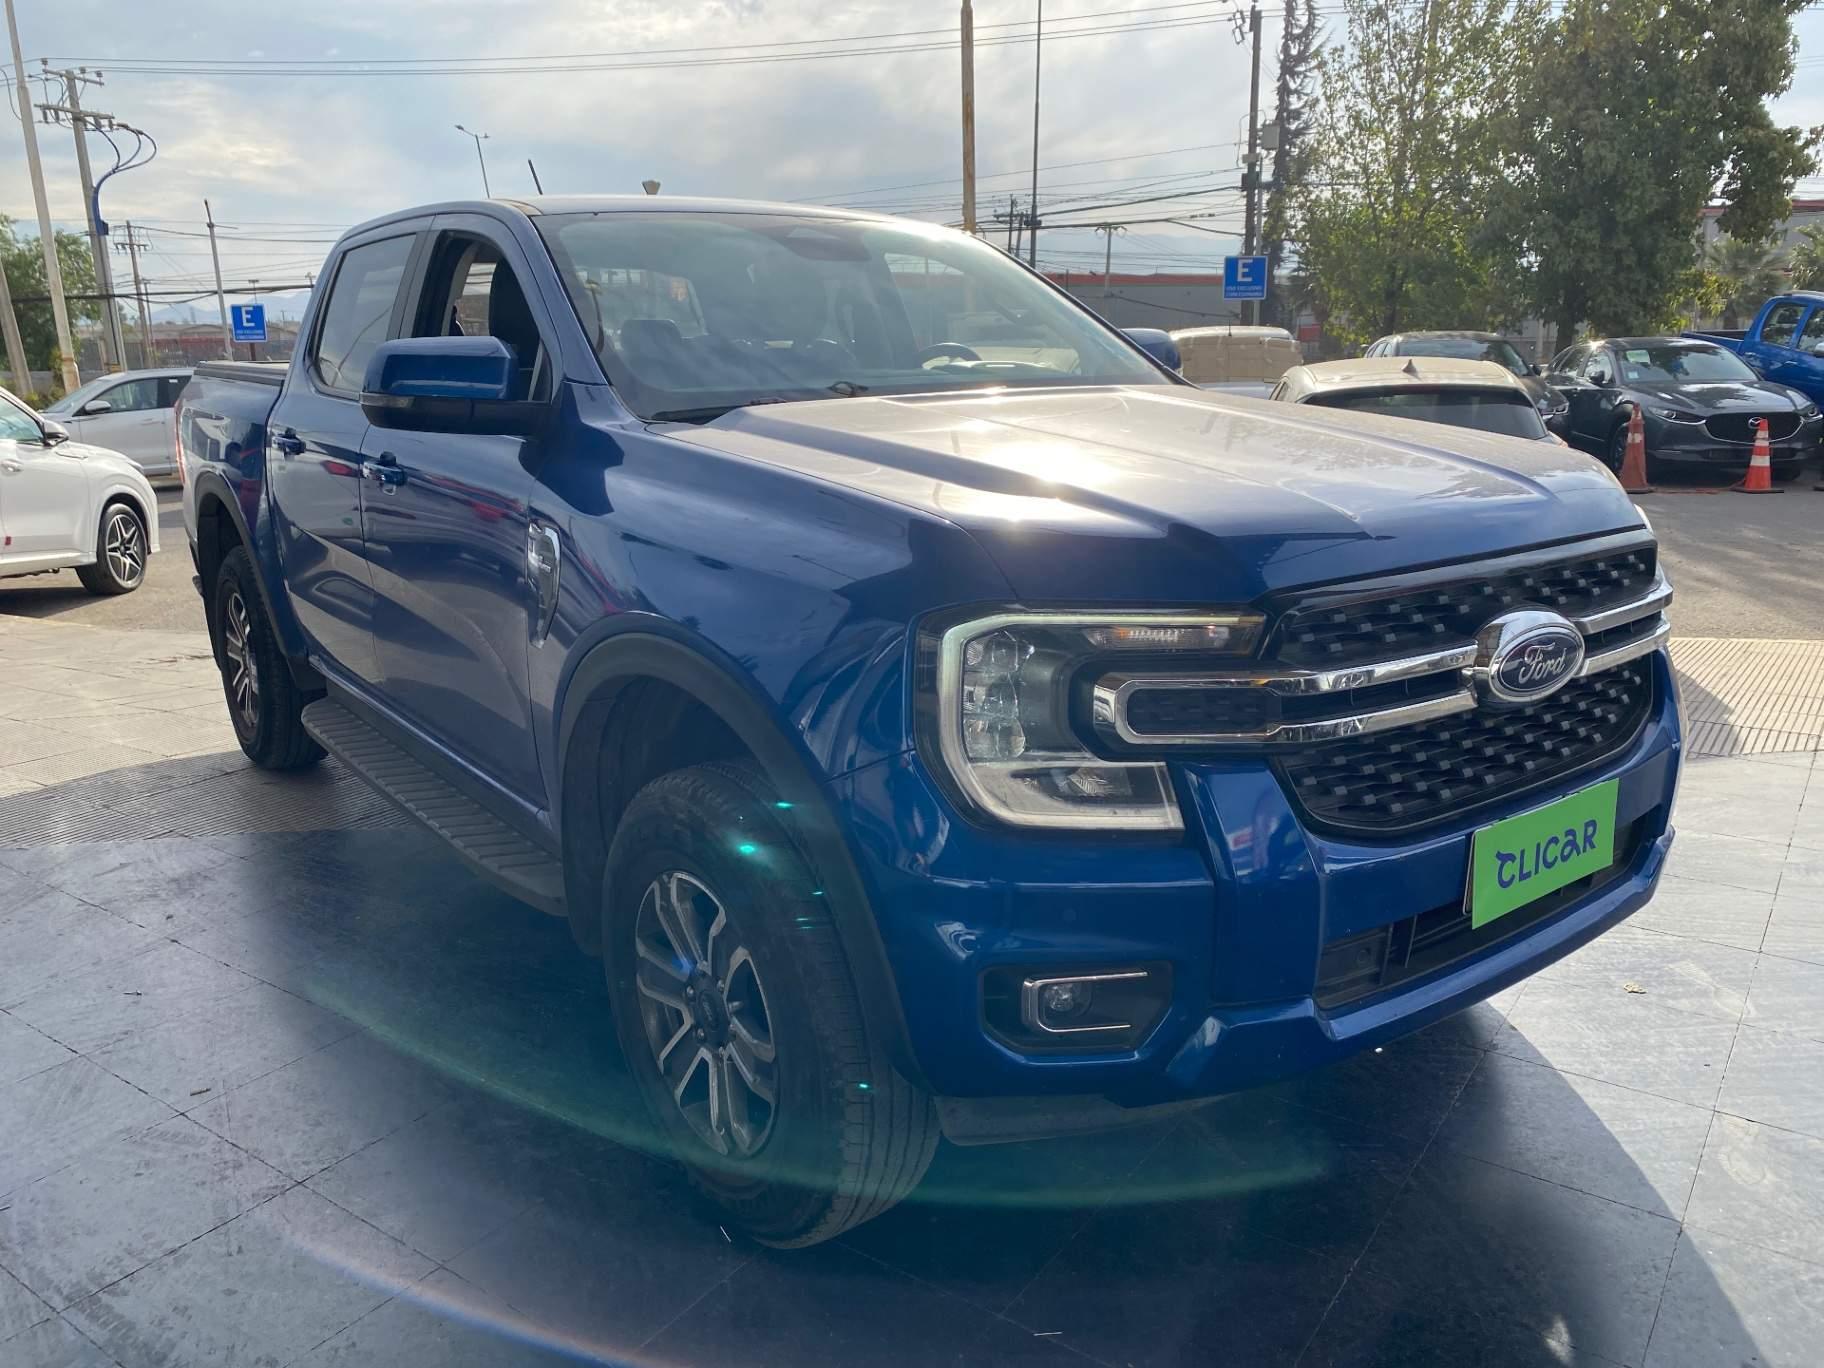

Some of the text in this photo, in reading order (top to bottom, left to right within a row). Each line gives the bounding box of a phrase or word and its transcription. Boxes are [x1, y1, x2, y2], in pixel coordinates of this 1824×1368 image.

[1237, 259, 1253, 281] E
[241, 306, 255, 326] E
[1518, 642, 1567, 684] Ford
